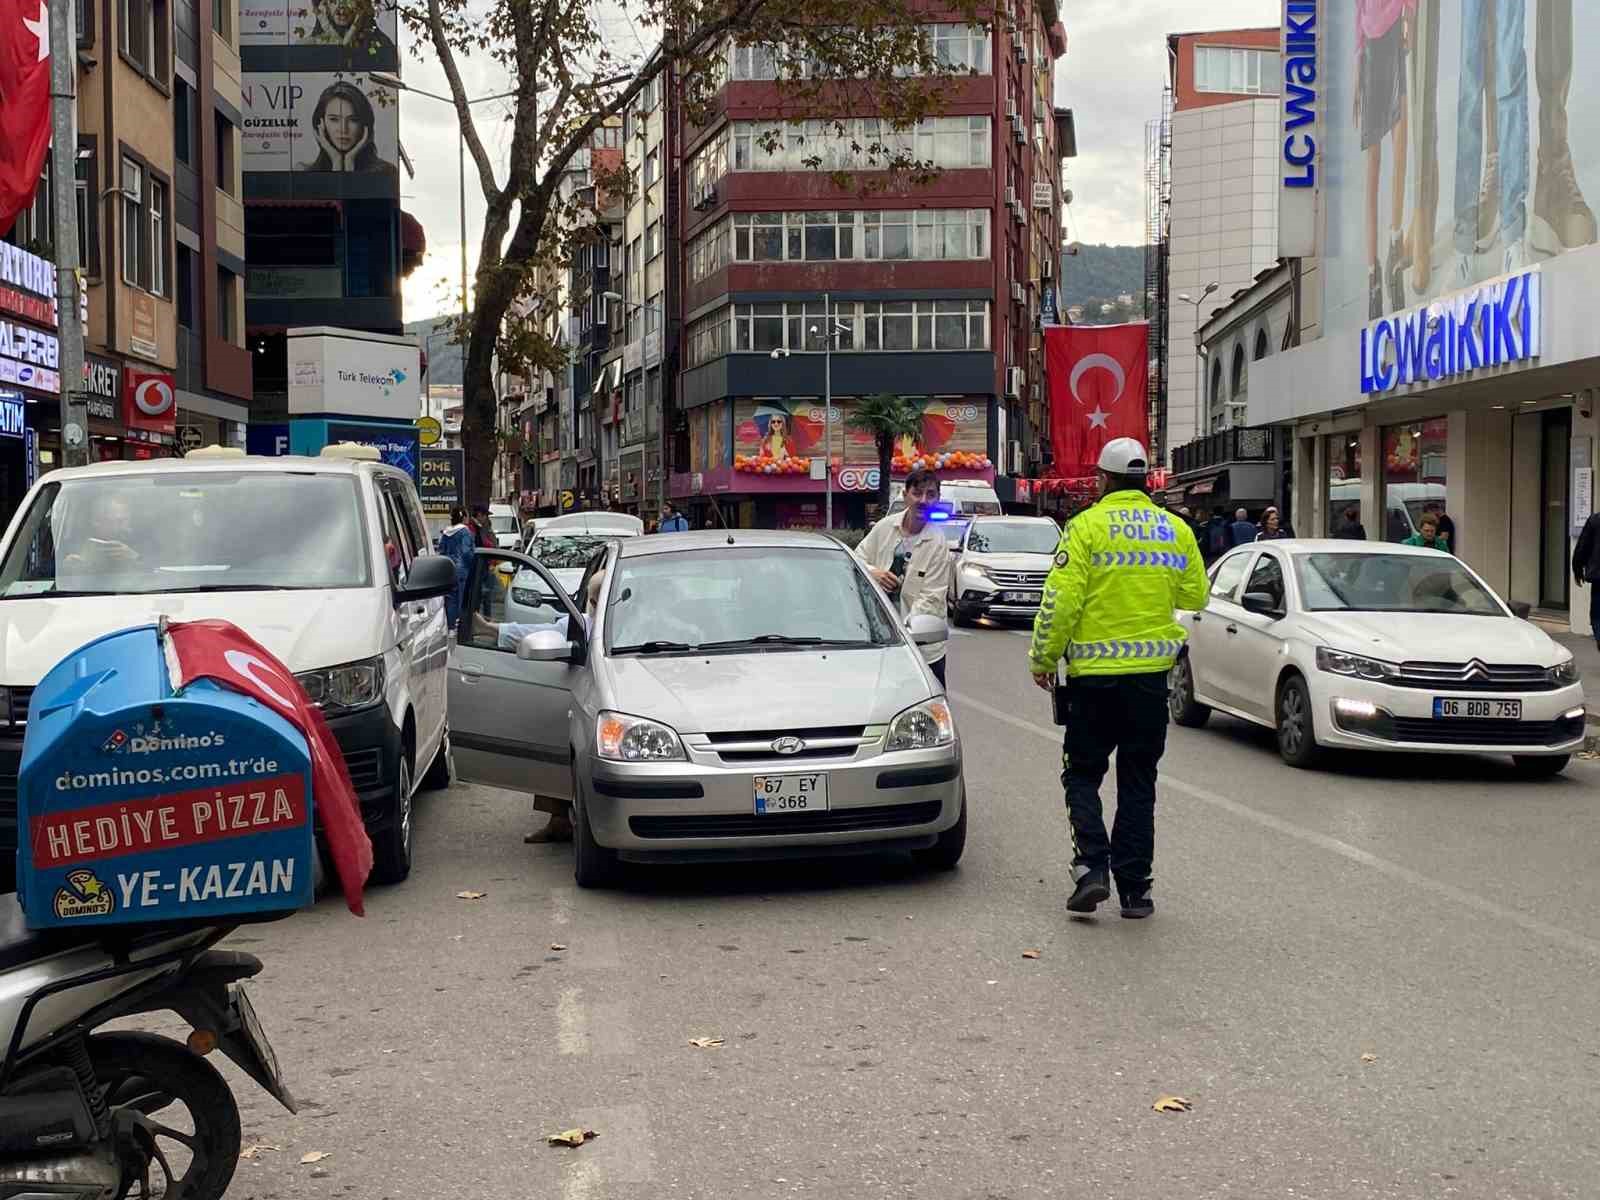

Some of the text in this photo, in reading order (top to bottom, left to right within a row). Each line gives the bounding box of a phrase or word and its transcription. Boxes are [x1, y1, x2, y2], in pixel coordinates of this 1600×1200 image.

[260, 84, 303, 110] VIP
[0, 239, 54, 299] ATURA
[338, 370, 356, 382] Türk
[359, 372, 394, 385] Telekom
[945, 406, 977, 420] eve
[421, 476, 456, 487] ZAYN
[840, 470, 880, 489] eve
[1443, 701, 1459, 716] 06
[1496, 702, 1520, 717] 755
[131, 730, 225, 753] Domino's
[764, 778, 818, 793] 67 EY
[778, 795, 807, 809] 368
[47, 788, 294, 859] HEDİYE PİZZA
[117, 858, 295, 909] YE-KAZAN
